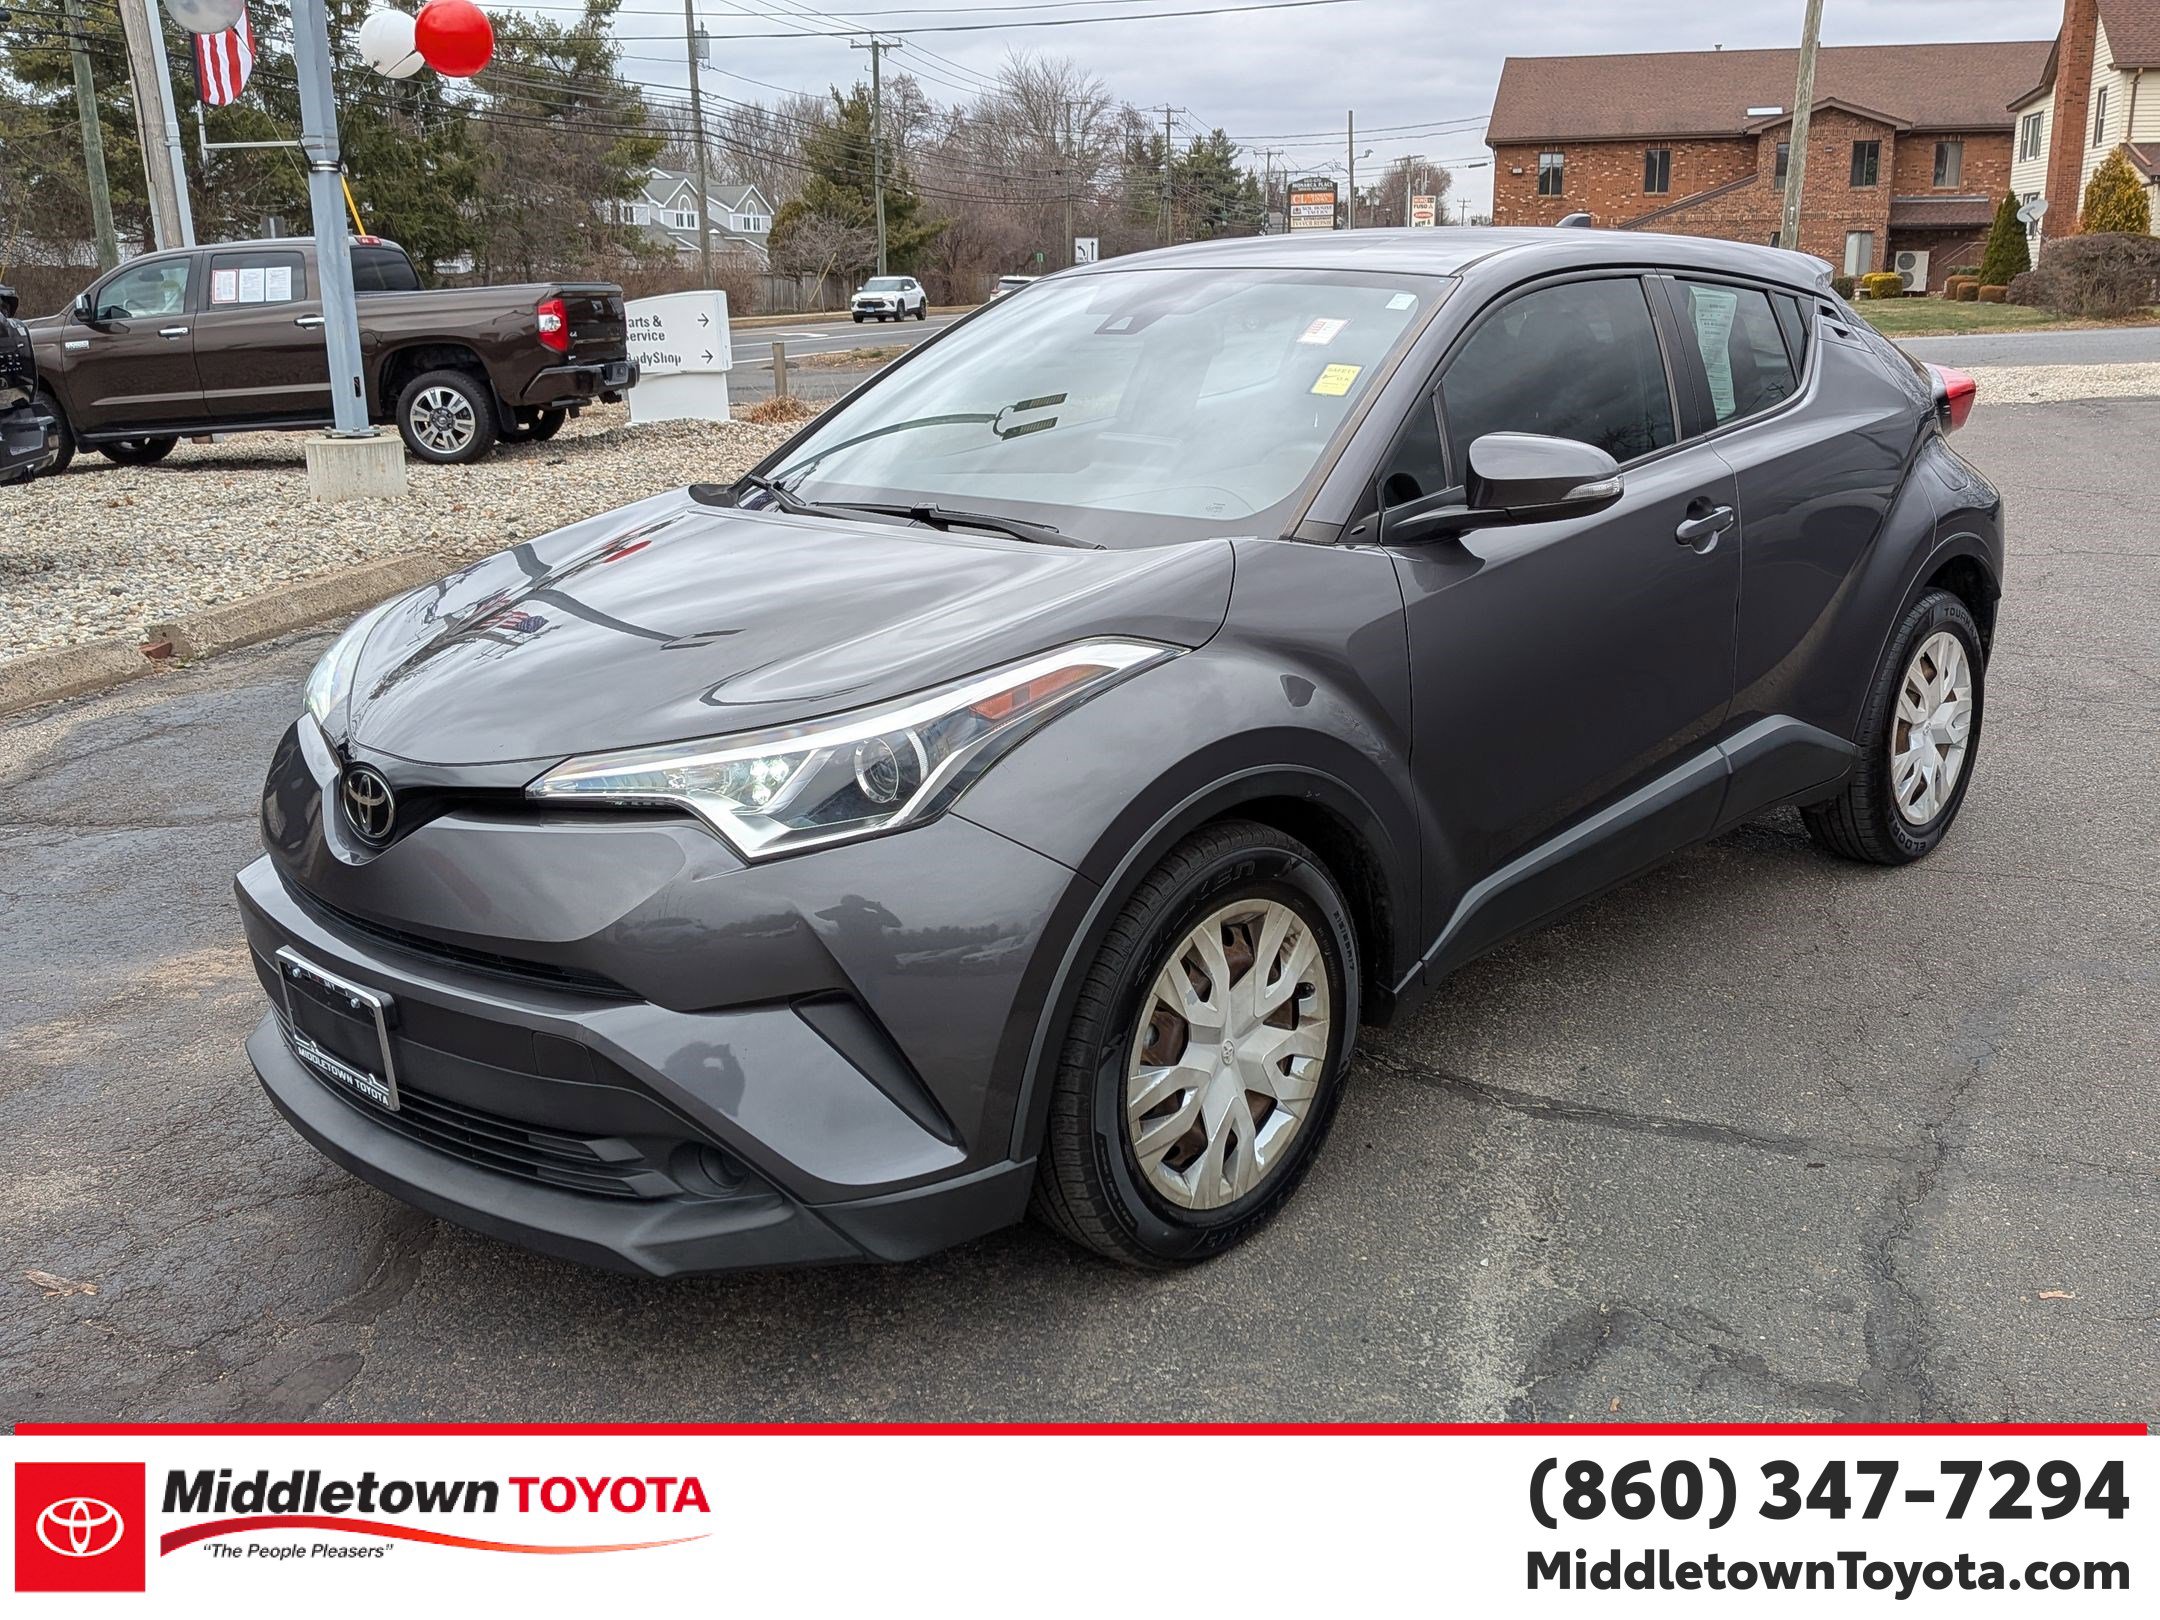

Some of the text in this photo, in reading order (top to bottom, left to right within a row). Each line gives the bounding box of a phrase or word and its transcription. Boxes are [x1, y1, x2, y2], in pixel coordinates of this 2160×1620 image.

[628, 315, 662, 328] arts &
[298, 1046, 389, 1107] MIDDLETOWN TOYOTA
